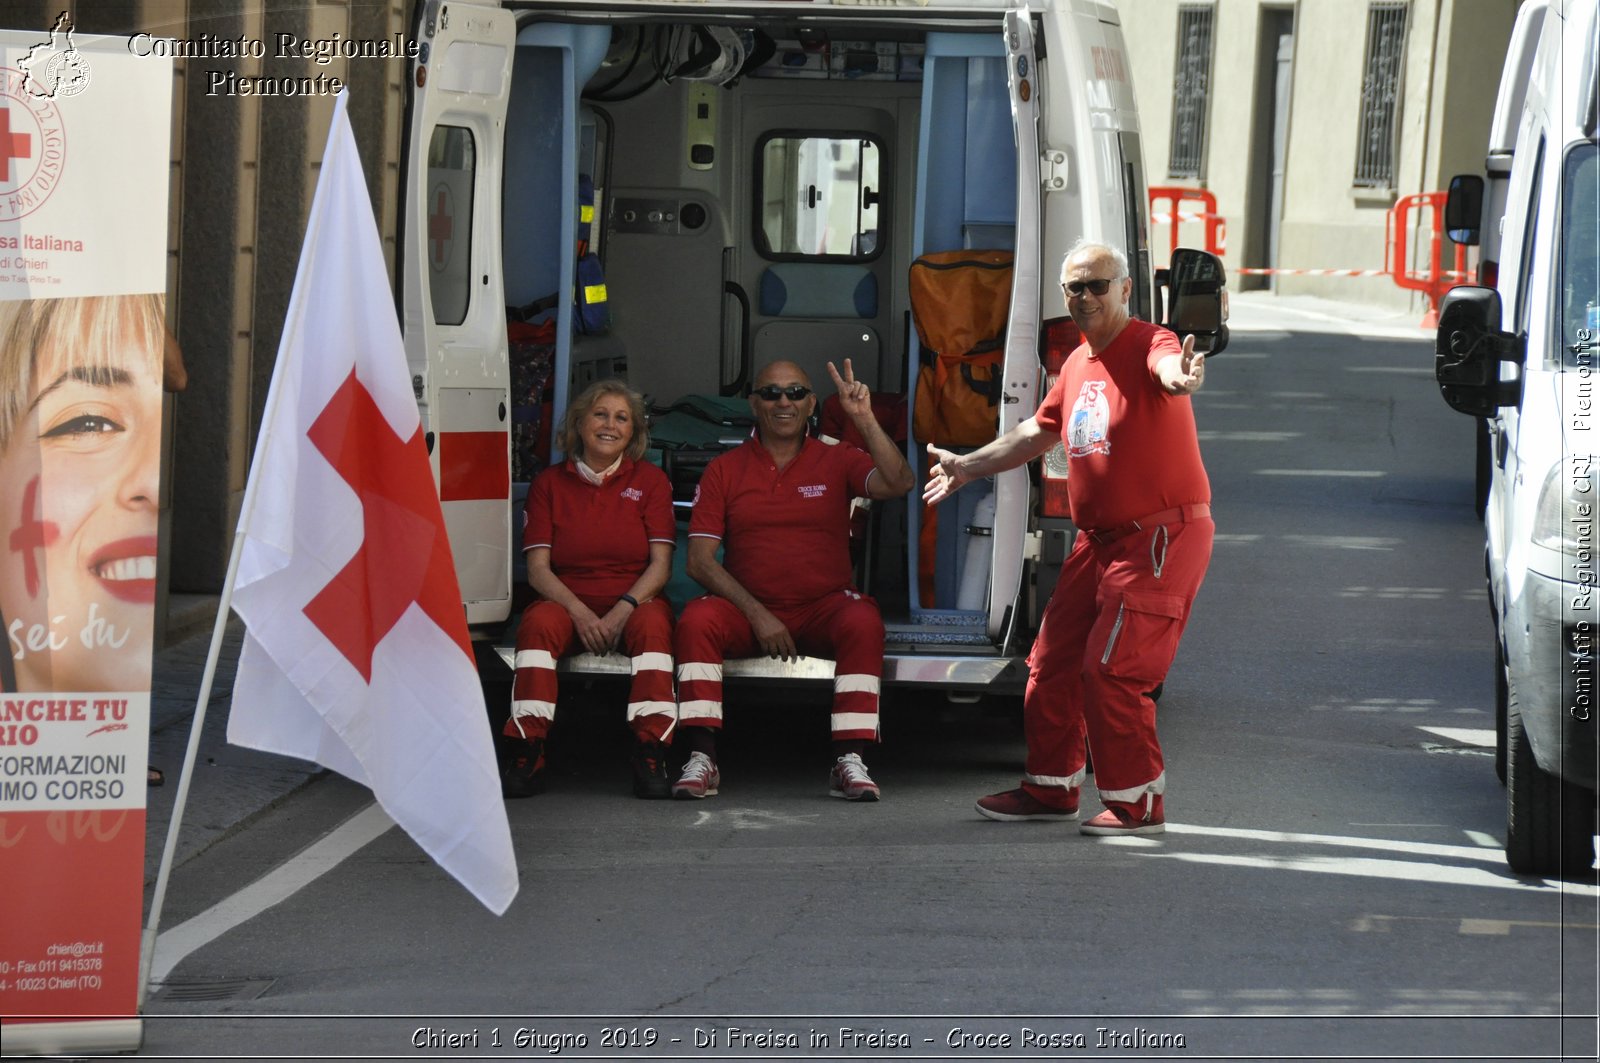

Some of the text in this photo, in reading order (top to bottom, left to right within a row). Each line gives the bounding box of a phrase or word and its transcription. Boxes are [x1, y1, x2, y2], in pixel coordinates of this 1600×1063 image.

[24, 234, 84, 252] Italiana
[14, 257, 48, 270] Chieri
[9, 602, 130, 660] sei tu
[93, 699, 128, 721] TU
[0, 755, 126, 776] ORMAZIONI
[45, 779, 124, 801] CORSO
[47, 942, 104, 957] chieri@cri.it
[17, 960, 37, 974] Fax
[38, 960, 56, 972] 011
[59, 958, 103, 972] 9415378
[16, 977, 46, 991] 10023
[48, 976, 77, 990] Chieri
[78, 975, 102, 990] (TO)
